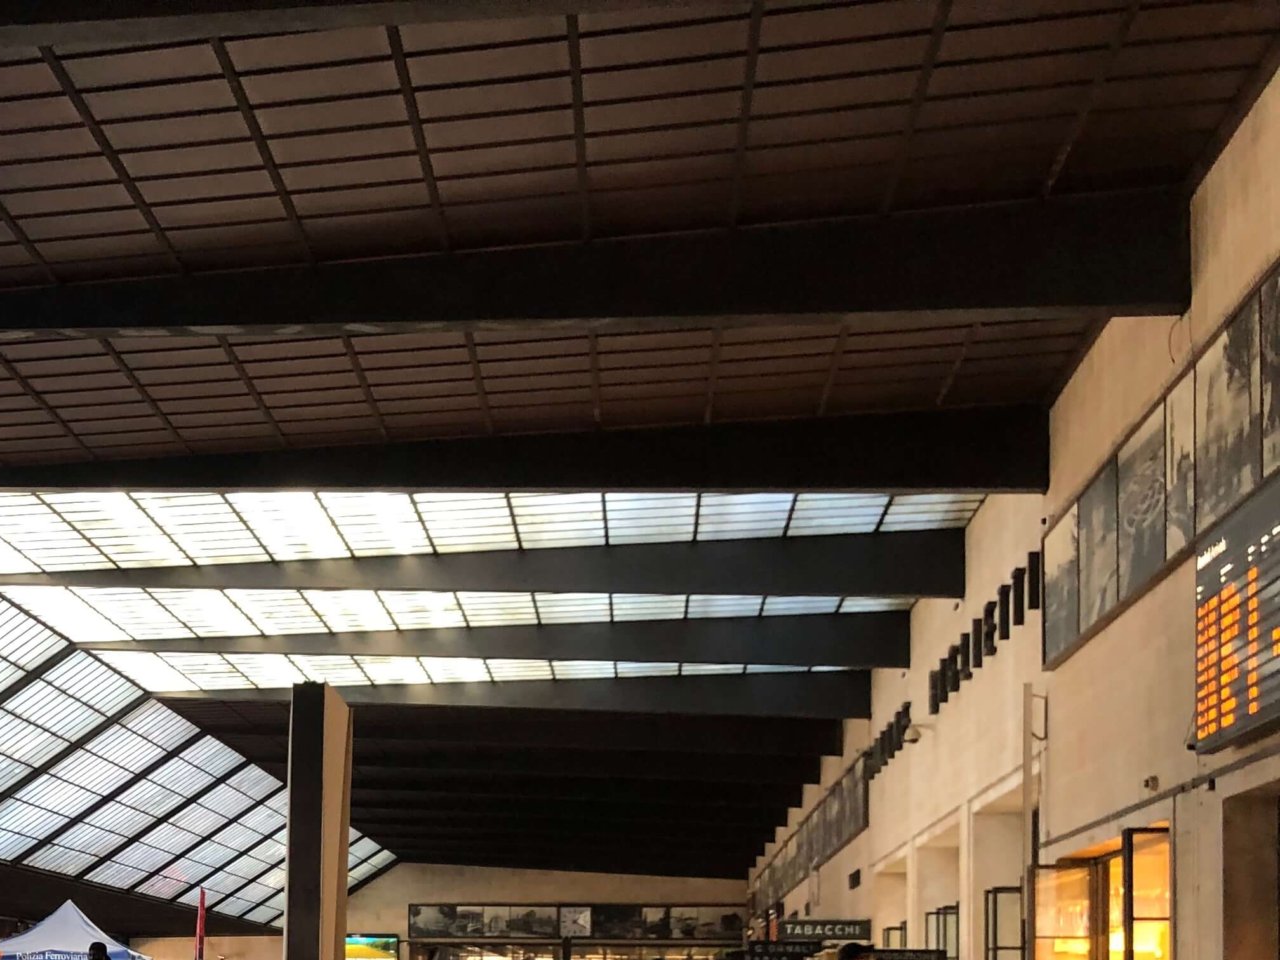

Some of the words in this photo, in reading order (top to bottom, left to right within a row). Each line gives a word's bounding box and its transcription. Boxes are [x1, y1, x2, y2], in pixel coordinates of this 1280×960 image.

[785, 924, 860, 935] TABACCHI
[16, 952, 43, 960] Polizia
[45, 951, 87, 960] Ferroviaria
